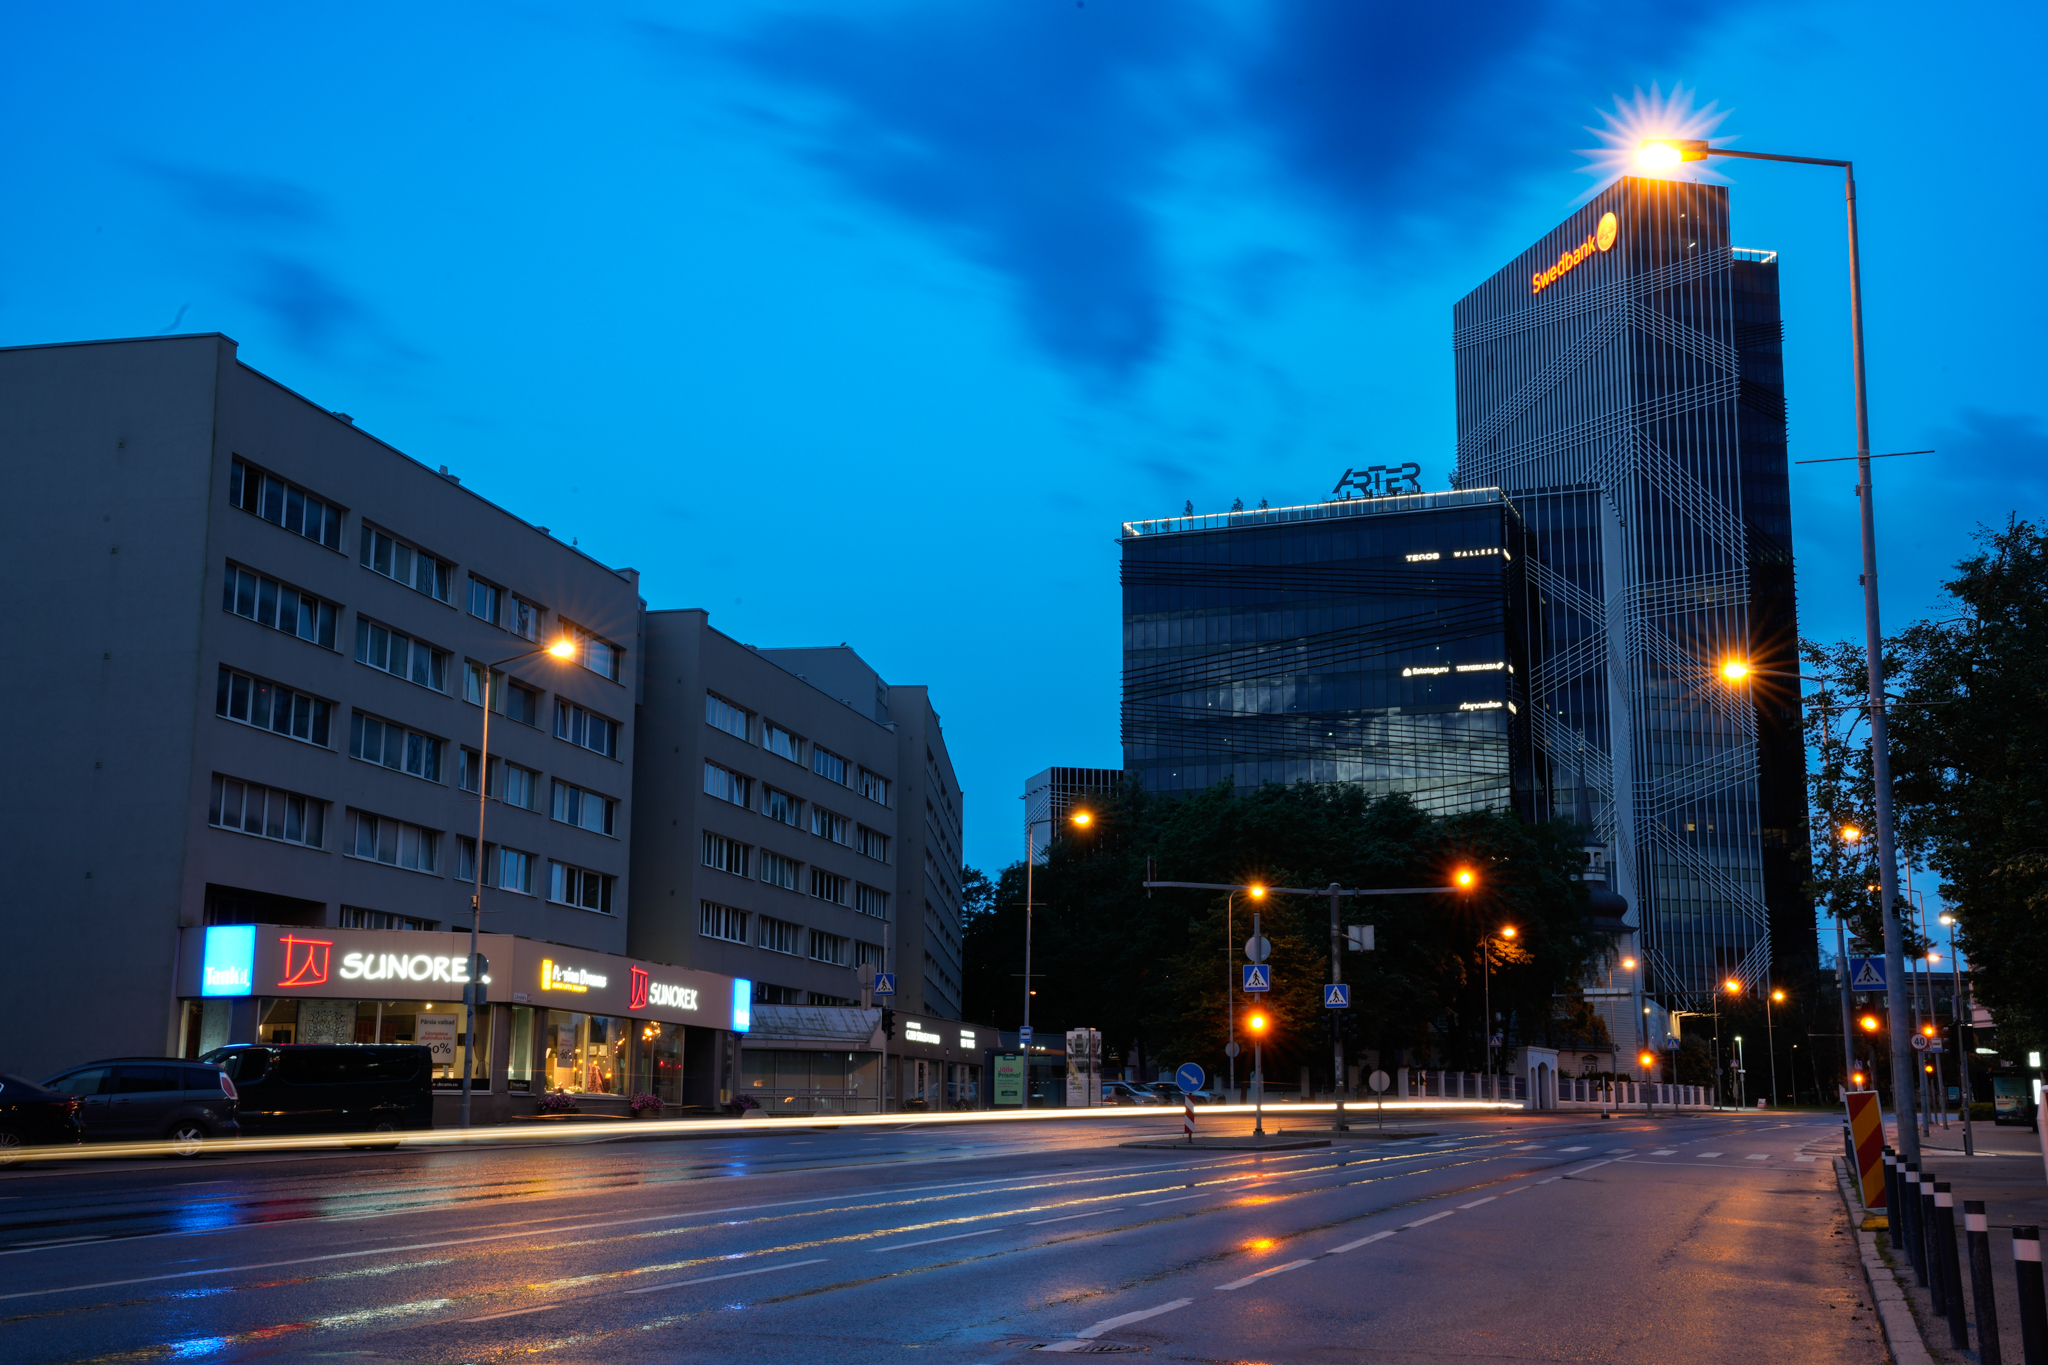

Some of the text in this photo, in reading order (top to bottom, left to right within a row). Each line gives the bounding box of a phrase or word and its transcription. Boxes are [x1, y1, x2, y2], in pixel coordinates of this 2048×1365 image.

[1532, 234, 1597, 294] Swedbank
[1332, 462, 1421, 495] ARTER
[1406, 552, 1440, 562] TEGOS
[1453, 548, 1499, 557] WALLESS
[1412, 667, 1449, 675] Estateguru
[1456, 663, 1497, 671] TERVISEKASSA
[552, 964, 579, 983] Persian
[579, 969, 607, 988] Dreams
[649, 982, 698, 1010] SUNOREK
[1914, 1037, 1925, 1046] 40
